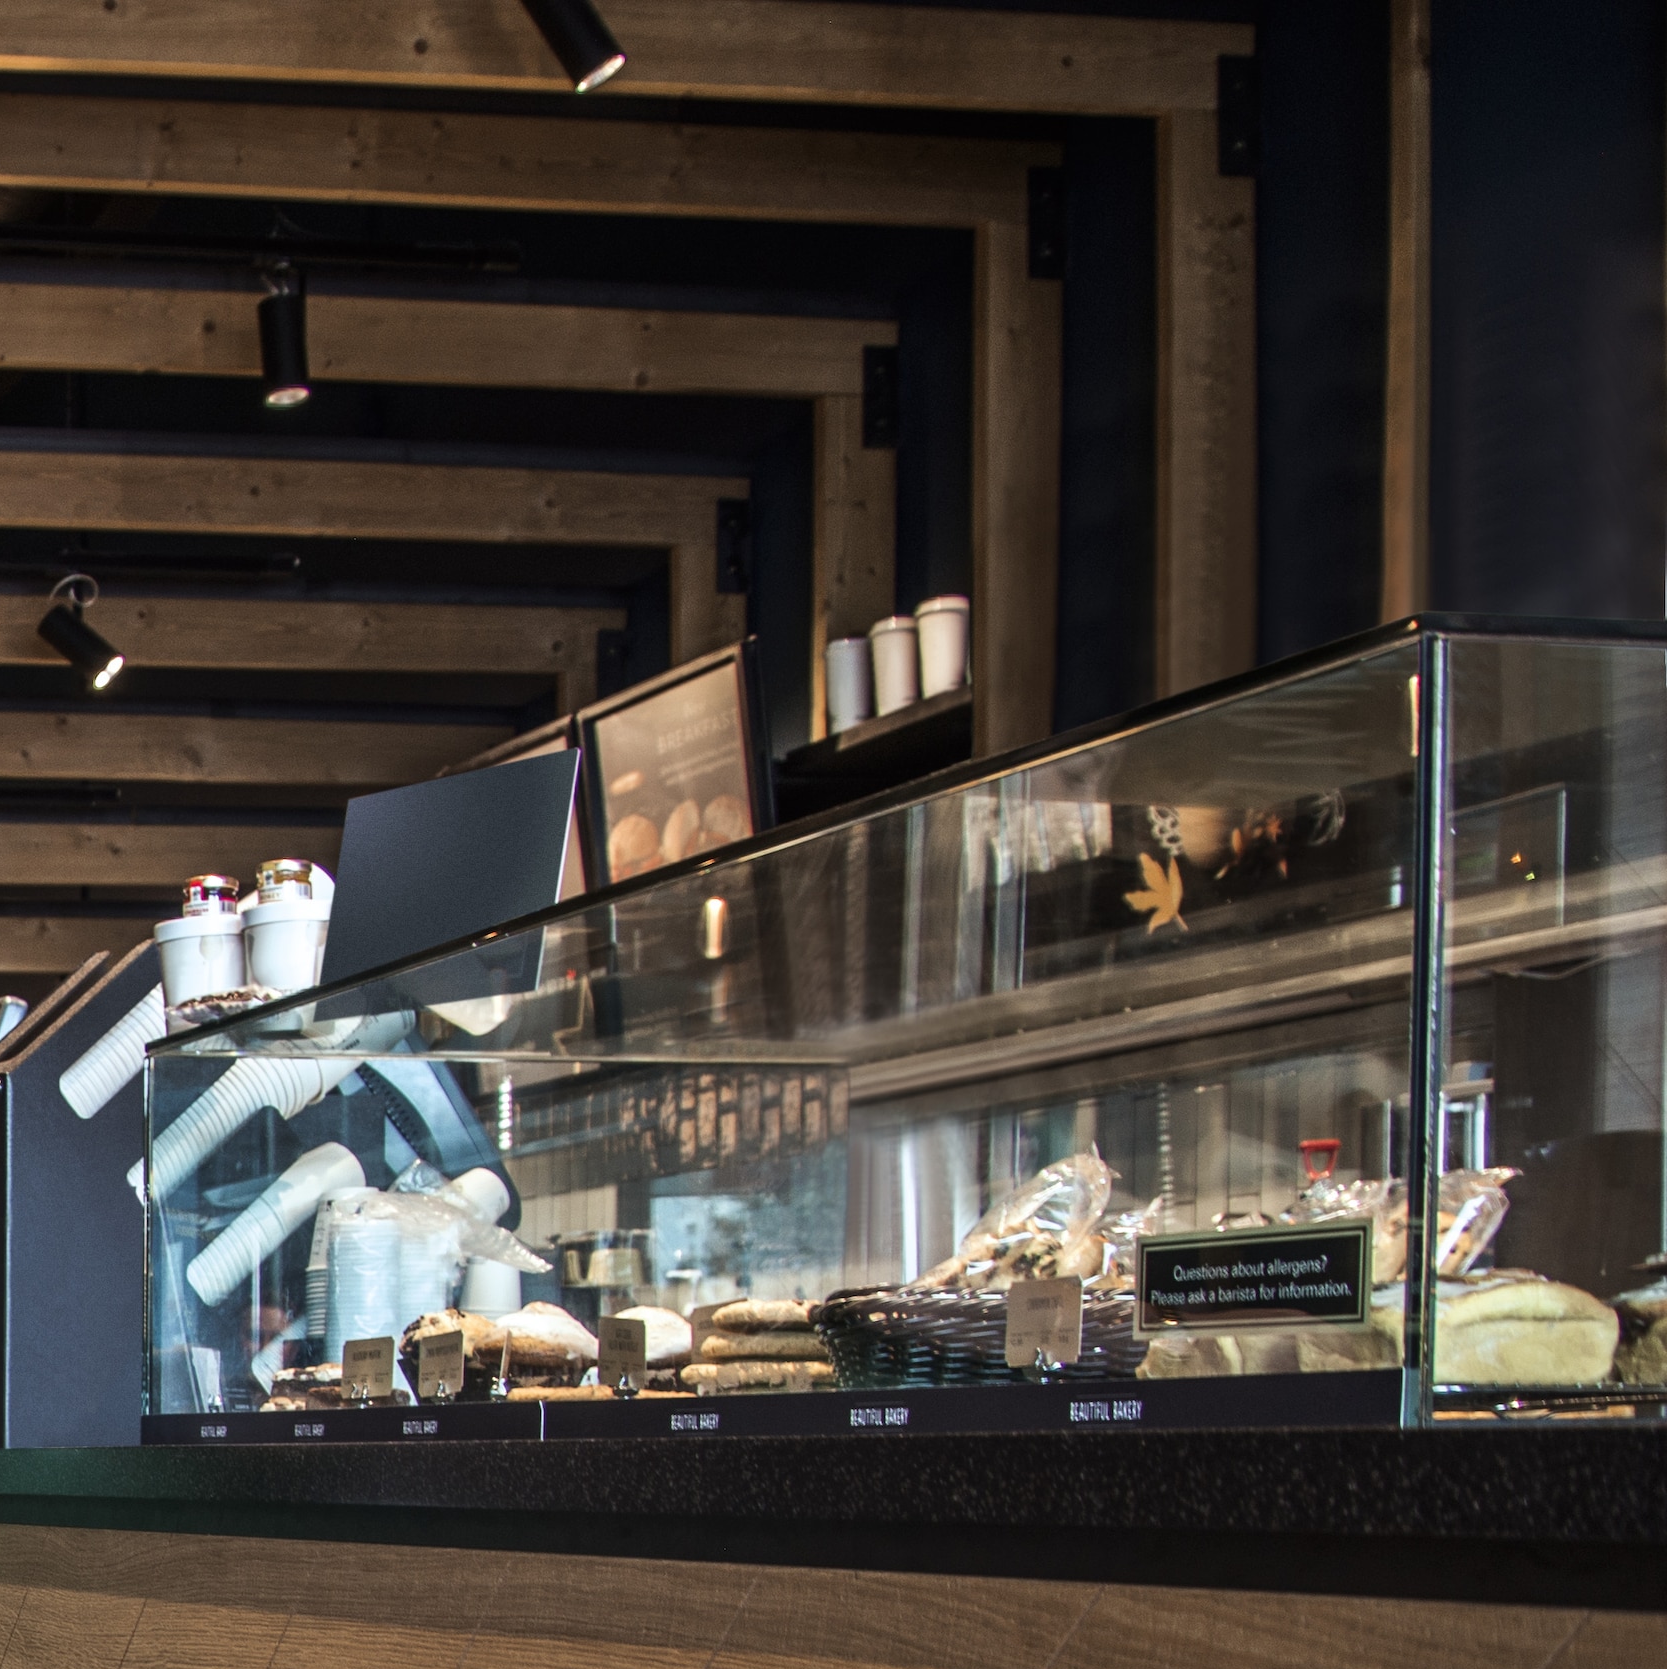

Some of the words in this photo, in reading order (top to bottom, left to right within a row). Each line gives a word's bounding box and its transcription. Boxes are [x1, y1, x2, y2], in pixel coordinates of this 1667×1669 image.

[1173, 1263, 1229, 1281] Questions
[1231, 1259, 1265, 1278] about
[1267, 1254, 1328, 1279] allergens?
[1151, 1289, 1186, 1306] Please
[1188, 1287, 1206, 1303] ask
[1208, 1290, 1215, 1303] a
[1218, 1285, 1257, 1302] barista
[1259, 1283, 1276, 1300] for
[1278, 1279, 1352, 1299] information.
[850, 1408, 883, 1426] BEAUTIFUL
[885, 1407, 909, 1426] BAKERY
[1070, 1401, 1110, 1421] BEAUTIFUL
[1113, 1400, 1143, 1421] BAKERY
[670, 1414, 698, 1430] BEAUTIFUL
[699, 1413, 719, 1430] BAKERY
